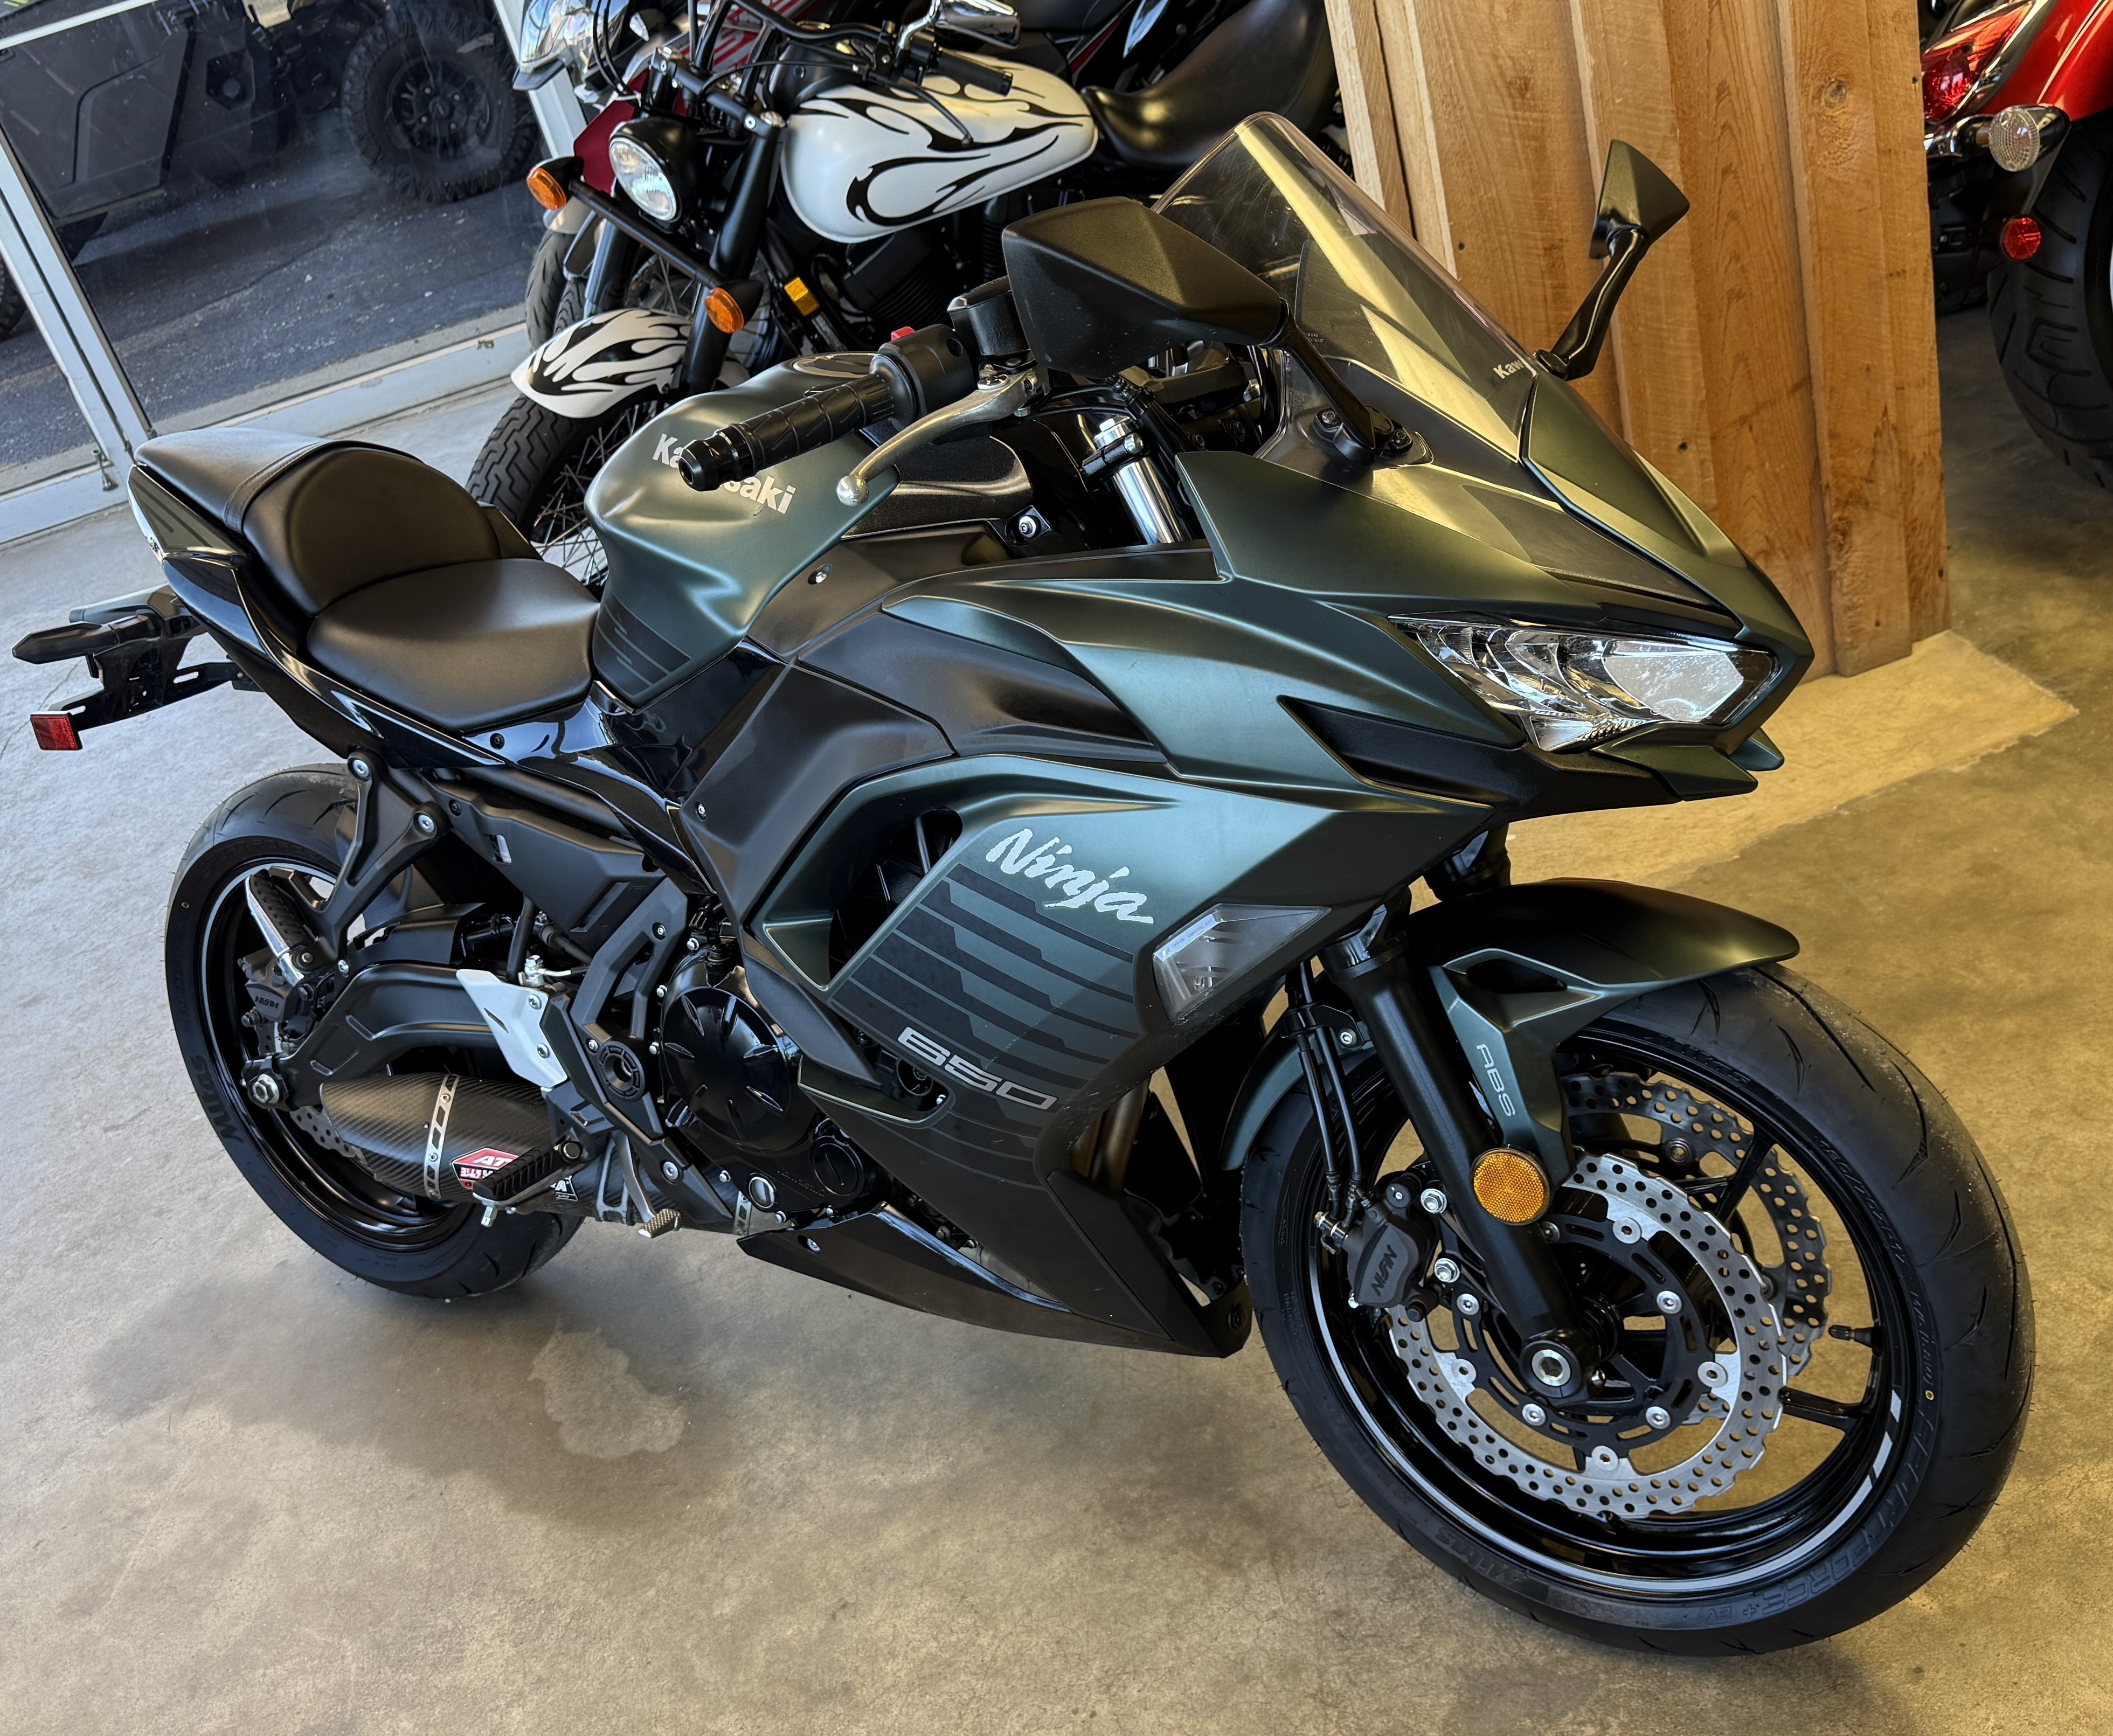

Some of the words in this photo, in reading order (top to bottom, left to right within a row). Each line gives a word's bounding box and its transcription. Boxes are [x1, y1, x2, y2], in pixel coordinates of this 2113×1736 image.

[1493, 359, 1525, 379] Kaw
[653, 433, 796, 514] Kasaki
[986, 828, 1154, 924] Ninja
[897, 1026, 1058, 1110] 650
[1476, 1044, 1516, 1116] ABS
